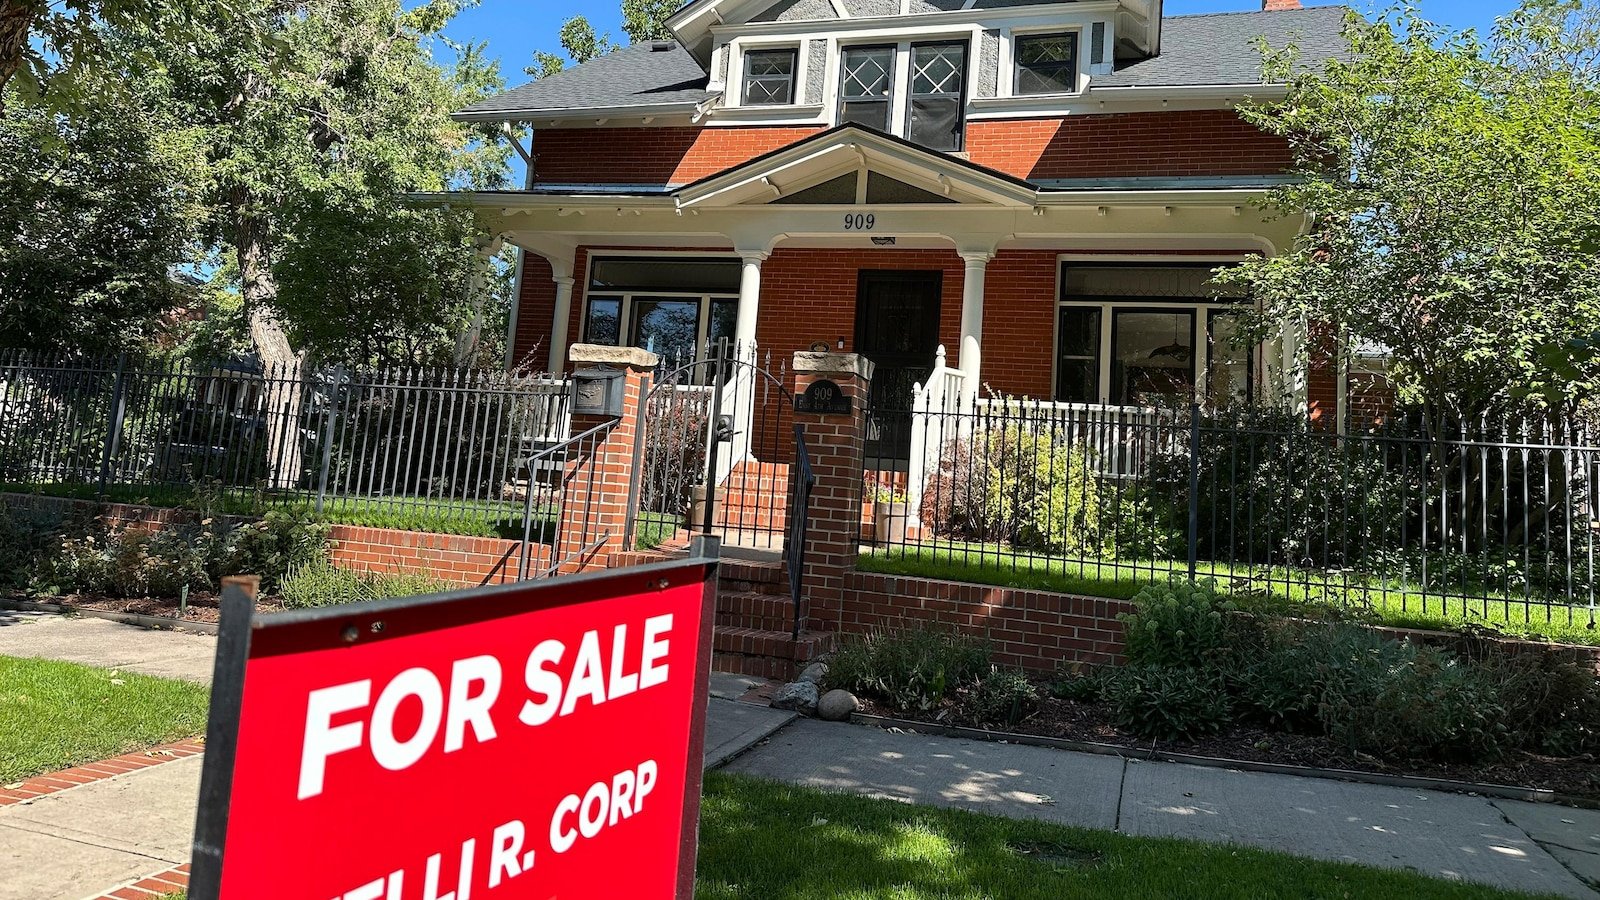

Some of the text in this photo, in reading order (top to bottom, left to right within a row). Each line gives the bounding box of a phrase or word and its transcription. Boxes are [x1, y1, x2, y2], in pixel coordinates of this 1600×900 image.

[844, 213, 875, 230] 909
[814, 387, 833, 400] 909
[297, 613, 674, 800] FOR SALE
[488, 820, 535, 889] R.
[549, 759, 658, 854] CORP
